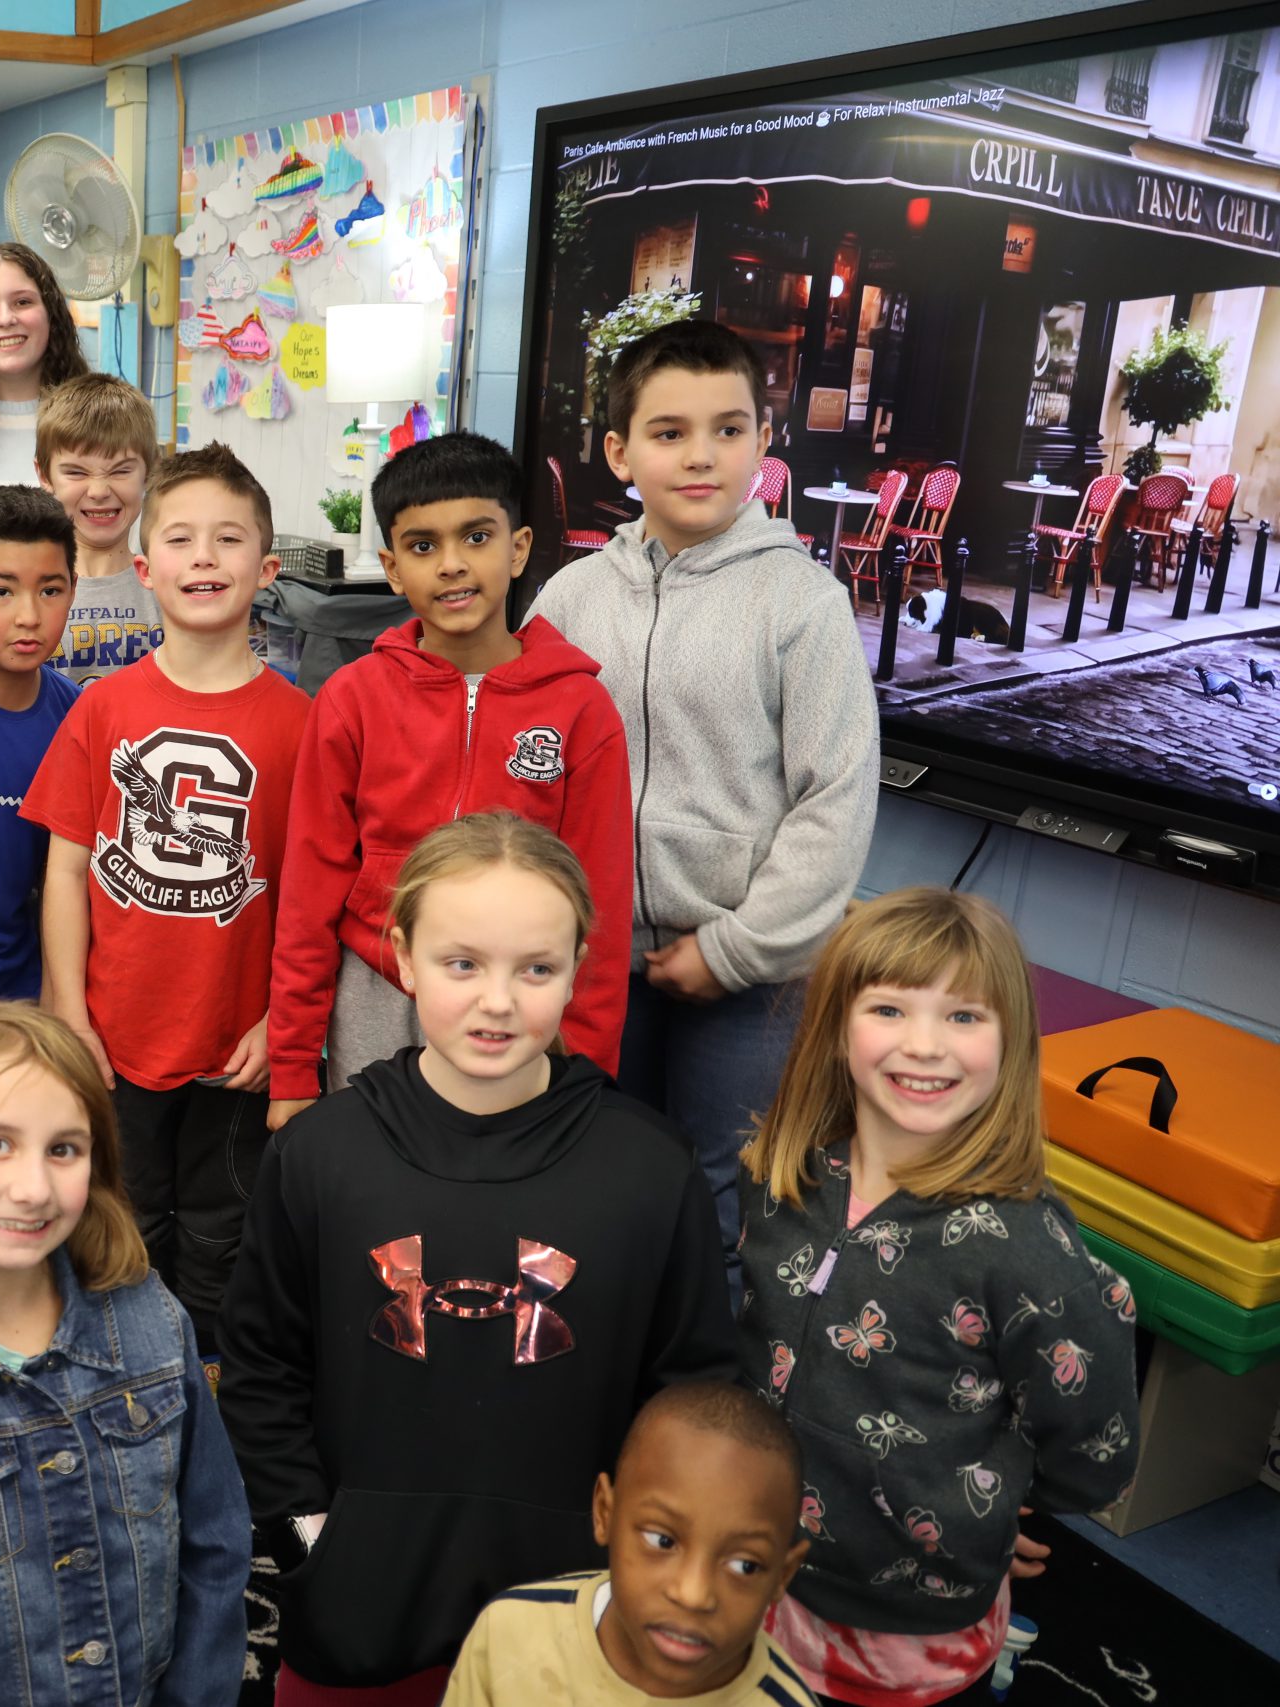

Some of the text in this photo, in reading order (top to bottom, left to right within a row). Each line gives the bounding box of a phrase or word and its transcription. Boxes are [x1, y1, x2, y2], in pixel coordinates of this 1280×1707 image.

[563, 146, 584, 158] Paris
[585, 143, 604, 155] Cafe
[605, 136, 646, 153] Ambience
[648, 134, 666, 147] with
[667, 126, 698, 144] French
[700, 125, 728, 140] Music
[730, 122, 744, 136] for
[746, 124, 752, 133] a
[754, 116, 781, 132] Good
[783, 112, 814, 128] Mood
[833, 107, 852, 122] For
[854, 103, 885, 120] Relax
[894, 89, 971, 114] Instrumental
[973, 88, 1006, 103] Jazz
[300, 329, 314, 342] Our
[293, 342, 320, 361] Hopes
[293, 367, 319, 379] Dreams
[67, 607, 136, 621] UFFALO
[511, 763, 561, 779] GLENCLIFF EAGLES
[107, 854, 244, 908] GLENCLIFF EAGLES
